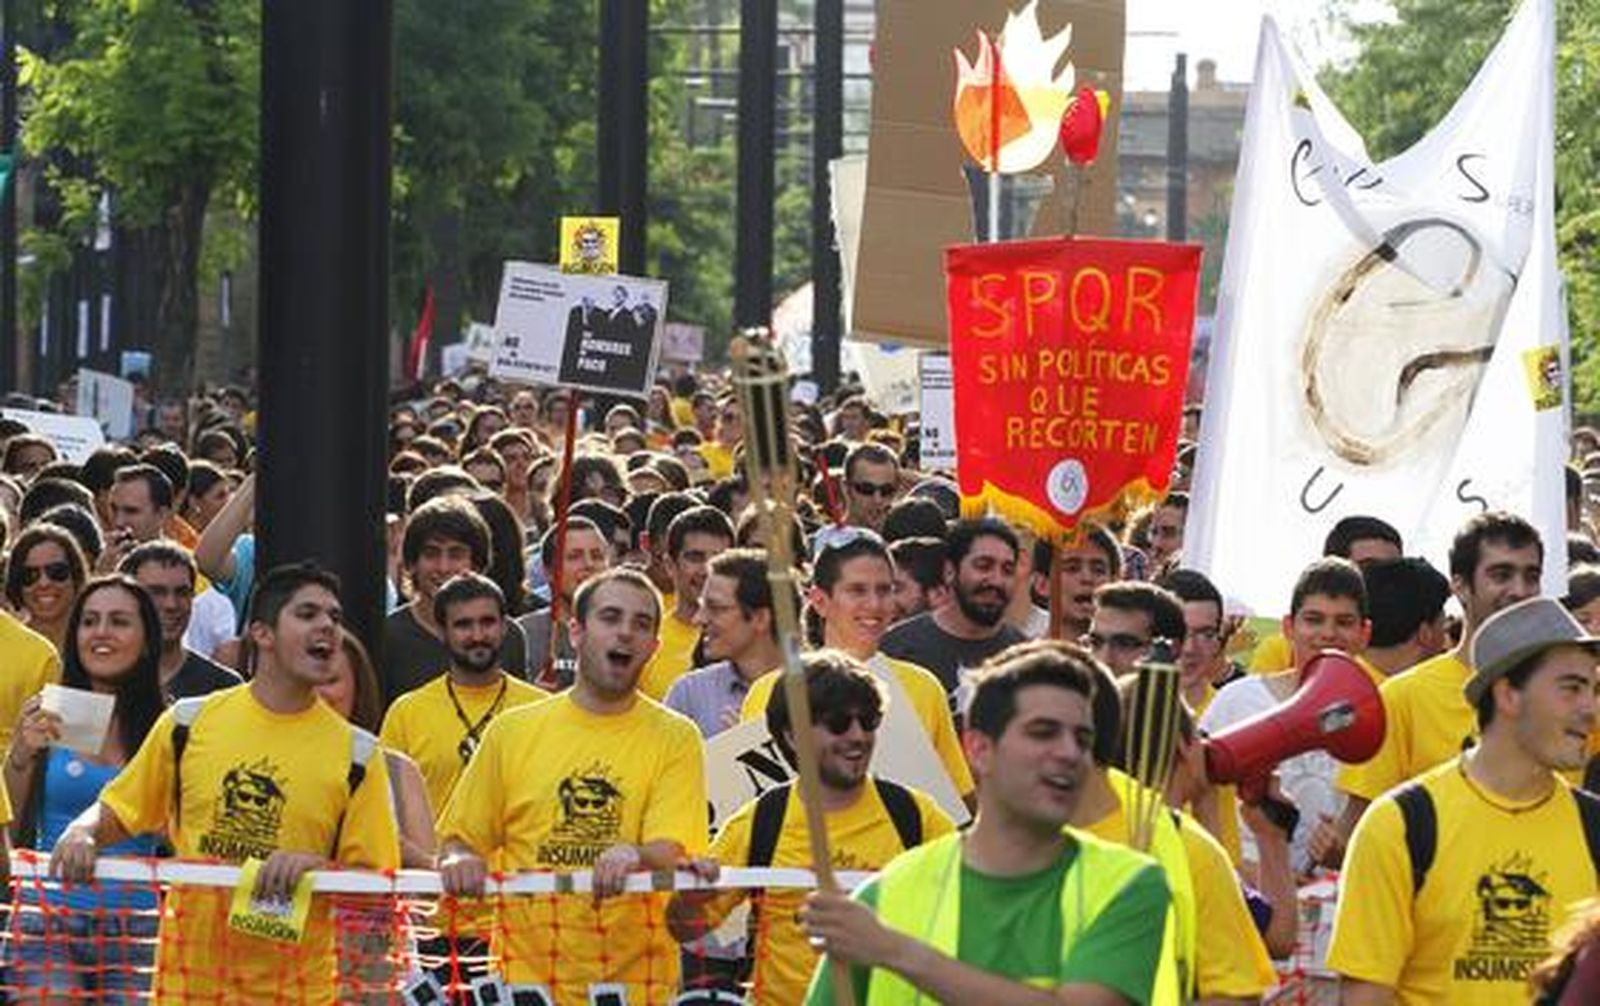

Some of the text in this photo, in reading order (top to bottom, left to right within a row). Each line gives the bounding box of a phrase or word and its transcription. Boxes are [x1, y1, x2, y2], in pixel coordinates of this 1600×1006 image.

[971, 266, 1164, 338] SPQR
[979, 354, 1028, 384] SIN
[1038, 339, 1171, 386] POLÍTICAS
[1029, 384, 1100, 417] QUE
[1006, 416, 1160, 454] RECORTEN
